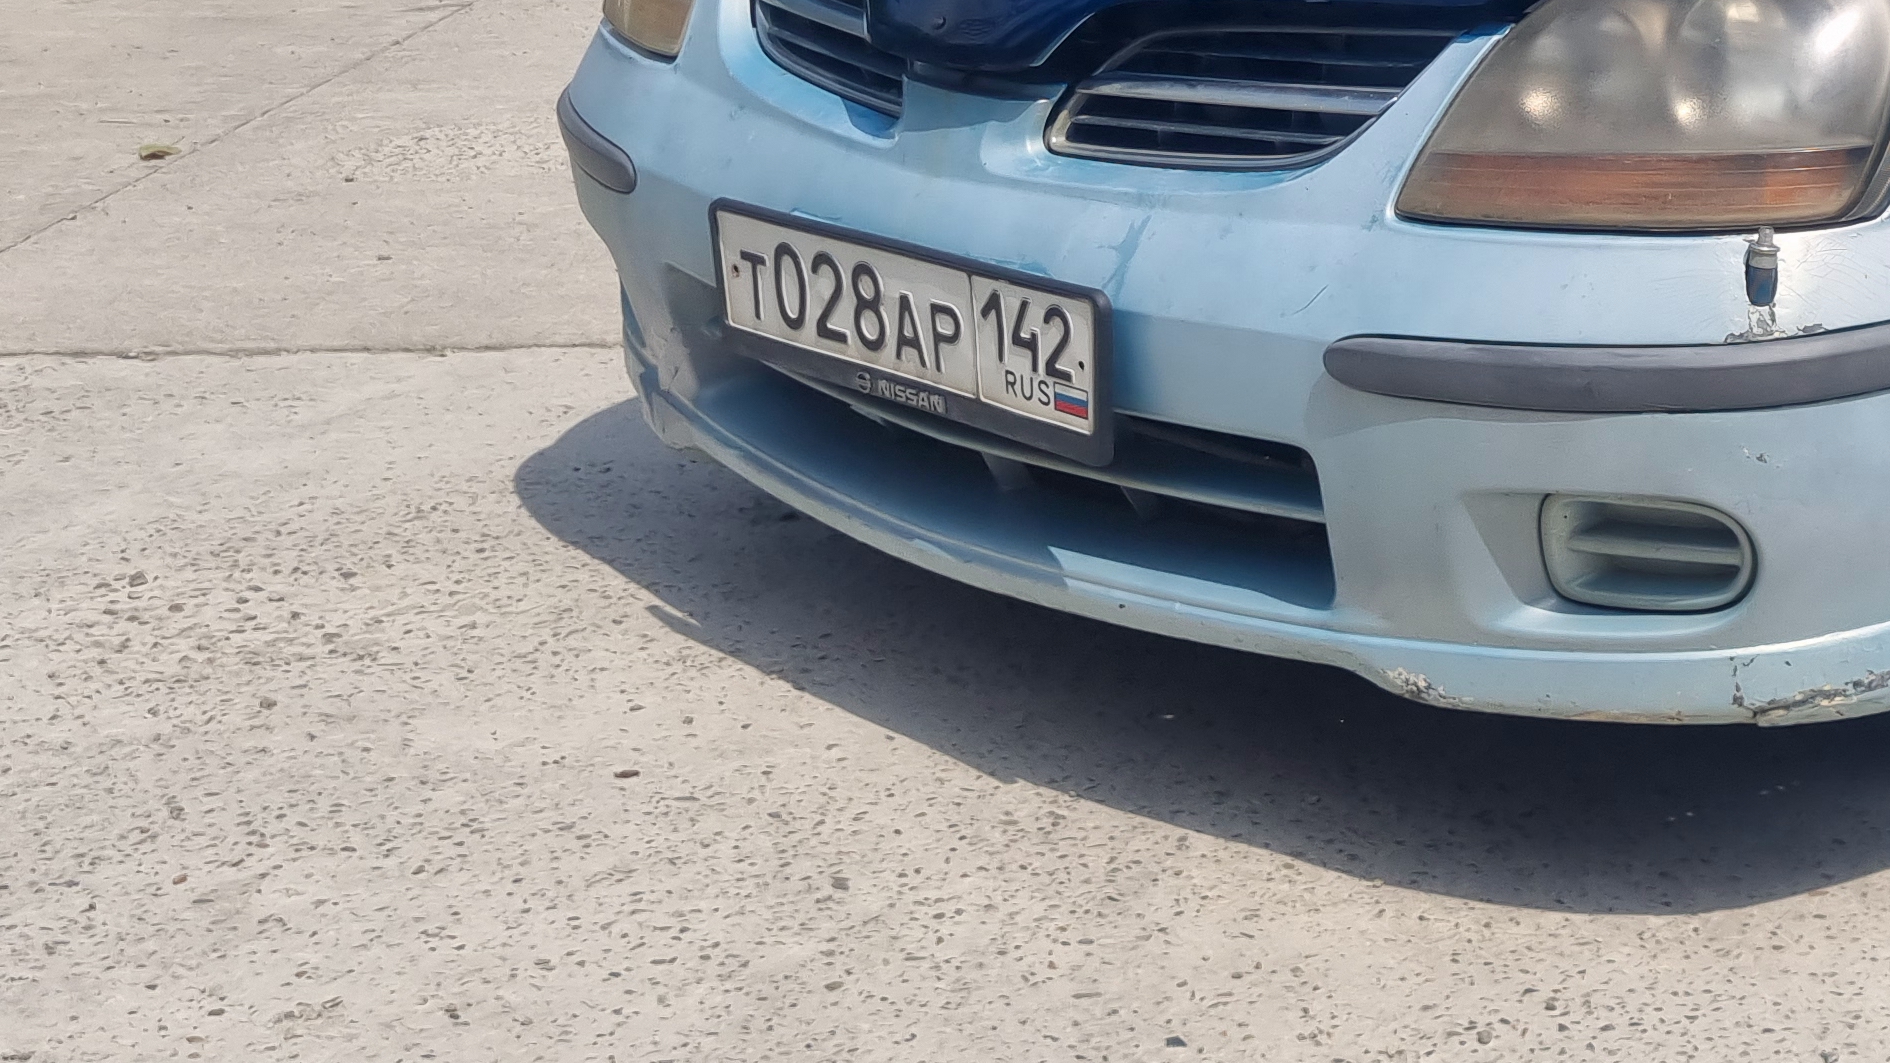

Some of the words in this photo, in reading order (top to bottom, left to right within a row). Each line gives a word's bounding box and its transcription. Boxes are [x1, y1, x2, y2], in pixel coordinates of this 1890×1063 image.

[980, 289, 1076, 383] 142
[877, 378, 948, 415] NISSAN
[1004, 369, 1051, 407] RUS
